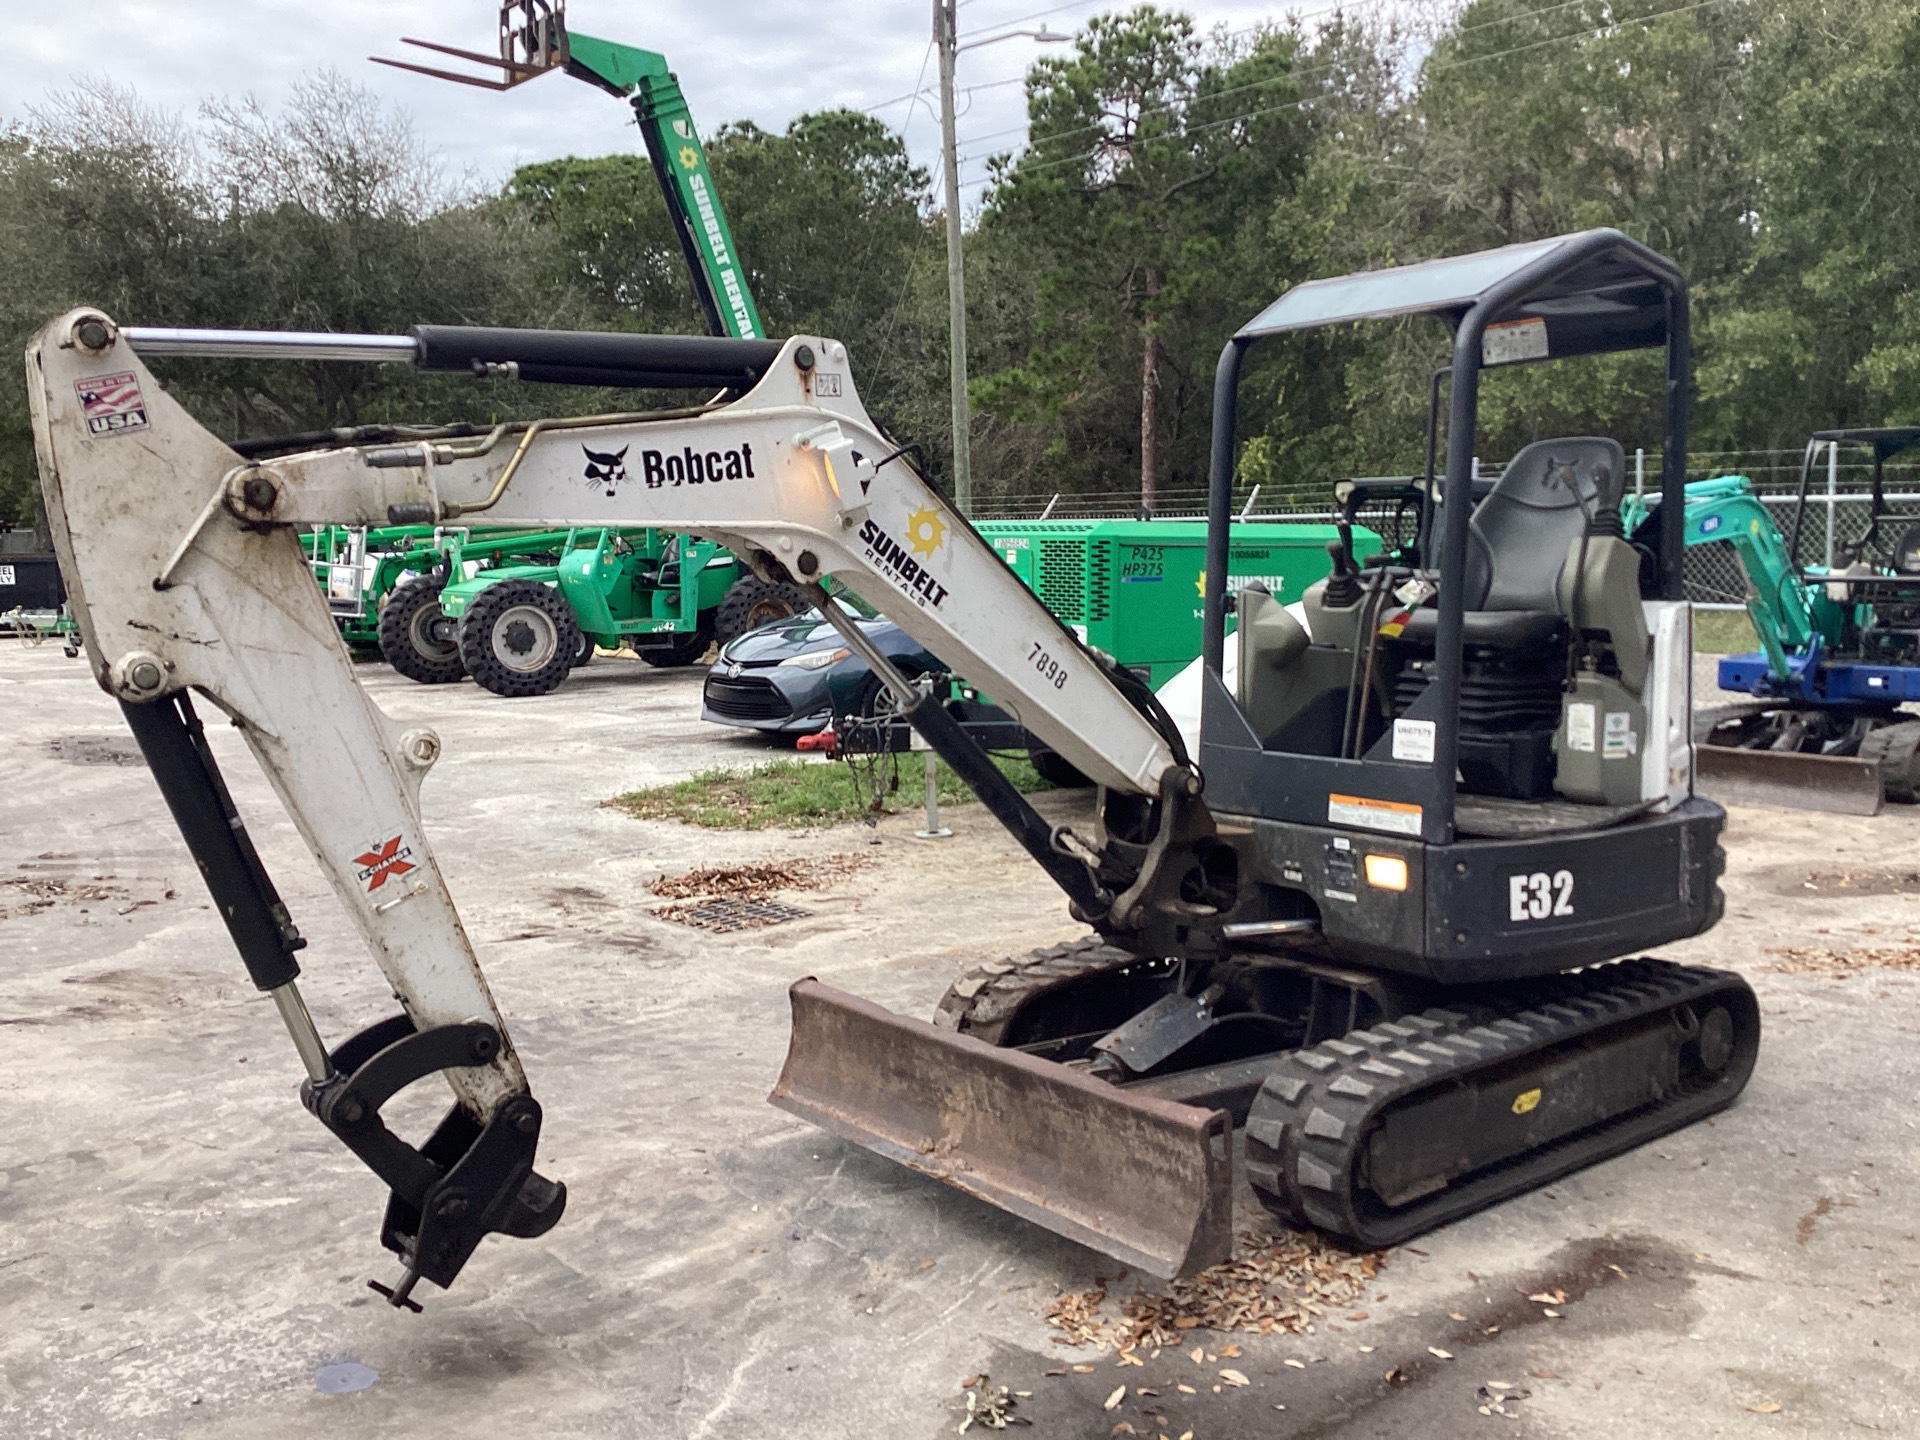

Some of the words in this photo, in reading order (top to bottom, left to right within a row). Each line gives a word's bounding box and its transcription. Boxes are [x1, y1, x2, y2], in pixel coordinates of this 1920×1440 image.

[688, 173, 731, 266] SUNBELT
[91, 411, 144, 431] USA
[641, 443, 755, 489] Bobcat
[858, 519, 949, 607] SUNBELT
[864, 548, 926, 607] RENTALS
[1122, 562, 1163, 576] HP375
[1131, 547, 1163, 560] P425
[1027, 641, 1068, 690] 7898
[1509, 869, 1575, 921] E32
